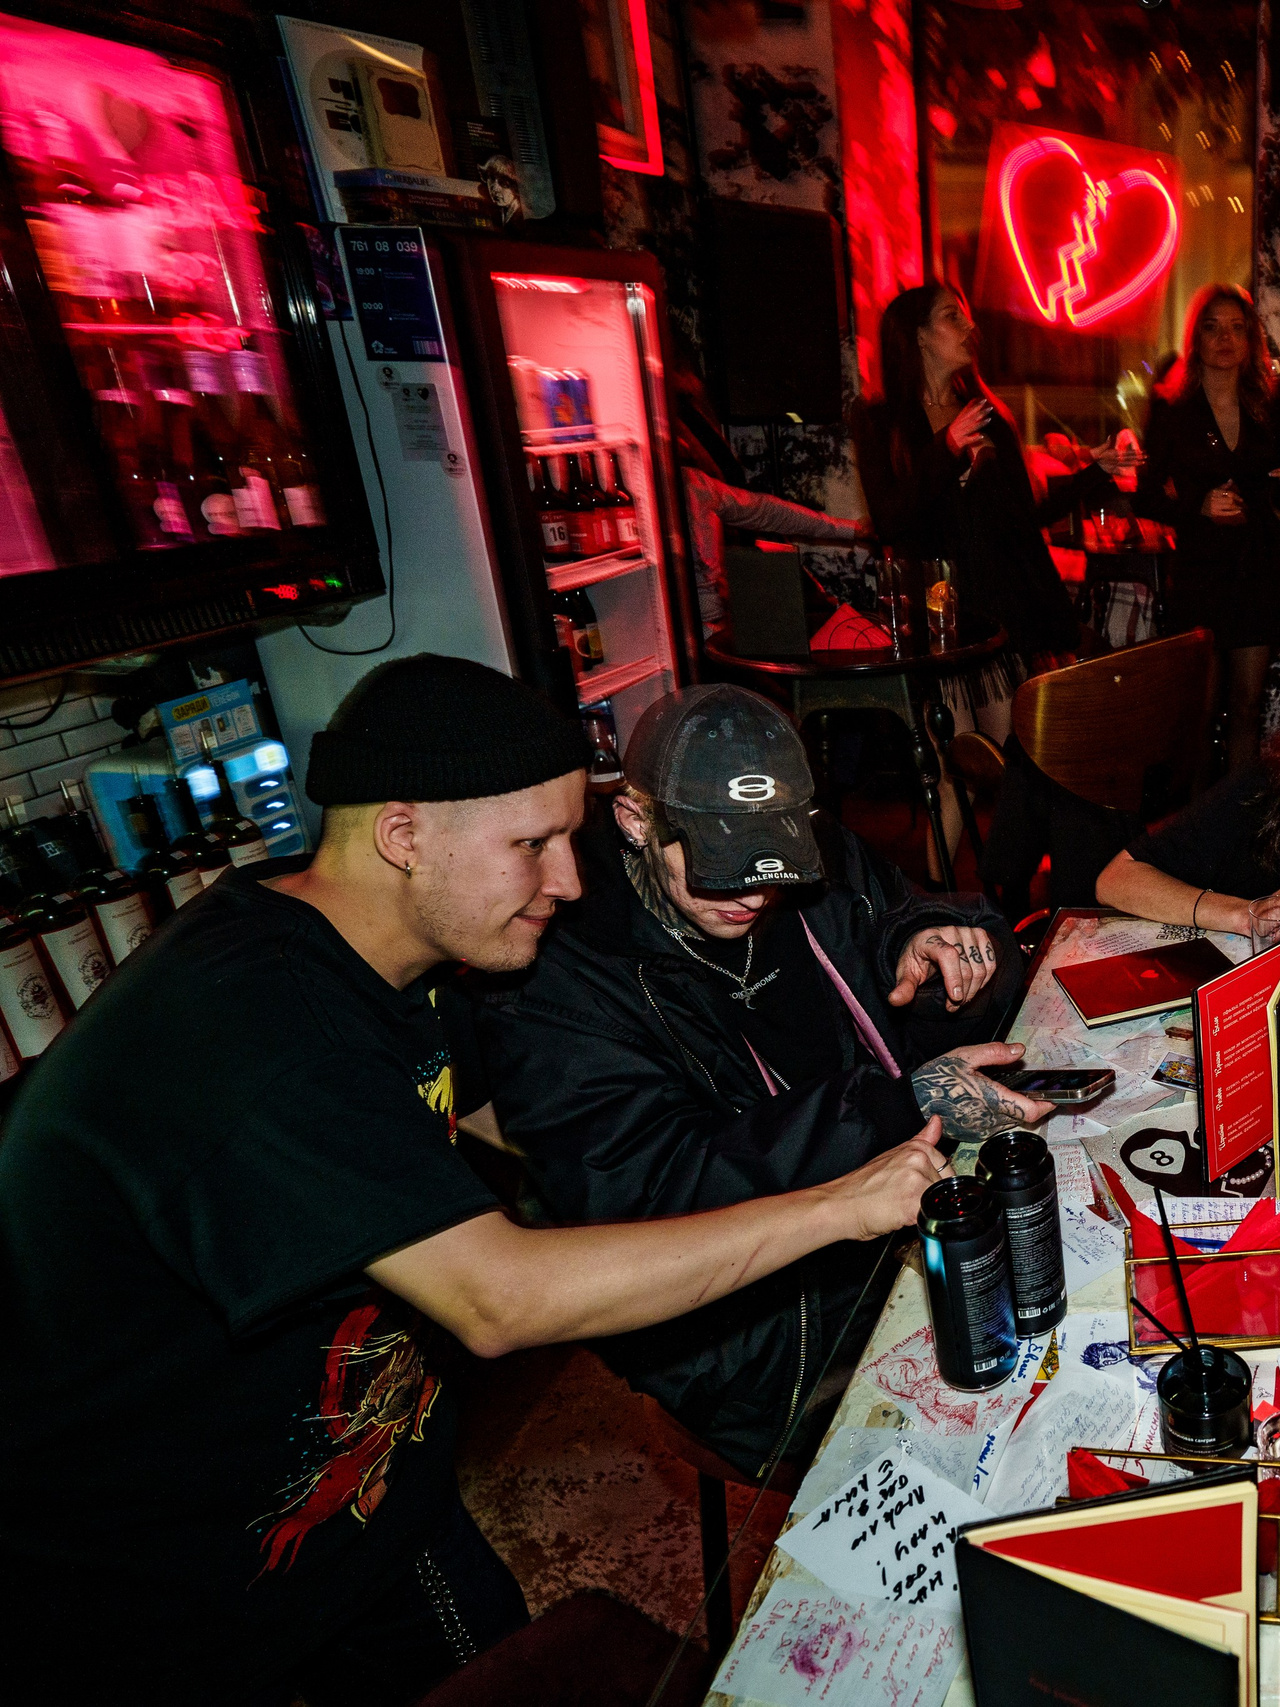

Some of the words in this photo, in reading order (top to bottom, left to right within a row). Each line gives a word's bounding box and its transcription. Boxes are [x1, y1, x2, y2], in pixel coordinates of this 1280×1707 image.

[375, 241, 390, 252] 08
[396, 241, 418, 252] 039
[362, 302, 384, 310] 00:00
[549, 527, 566, 541] 16
[173, 699, 209, 720] ЗАРЯДИ
[744, 872, 800, 884] BALENCIAGA
